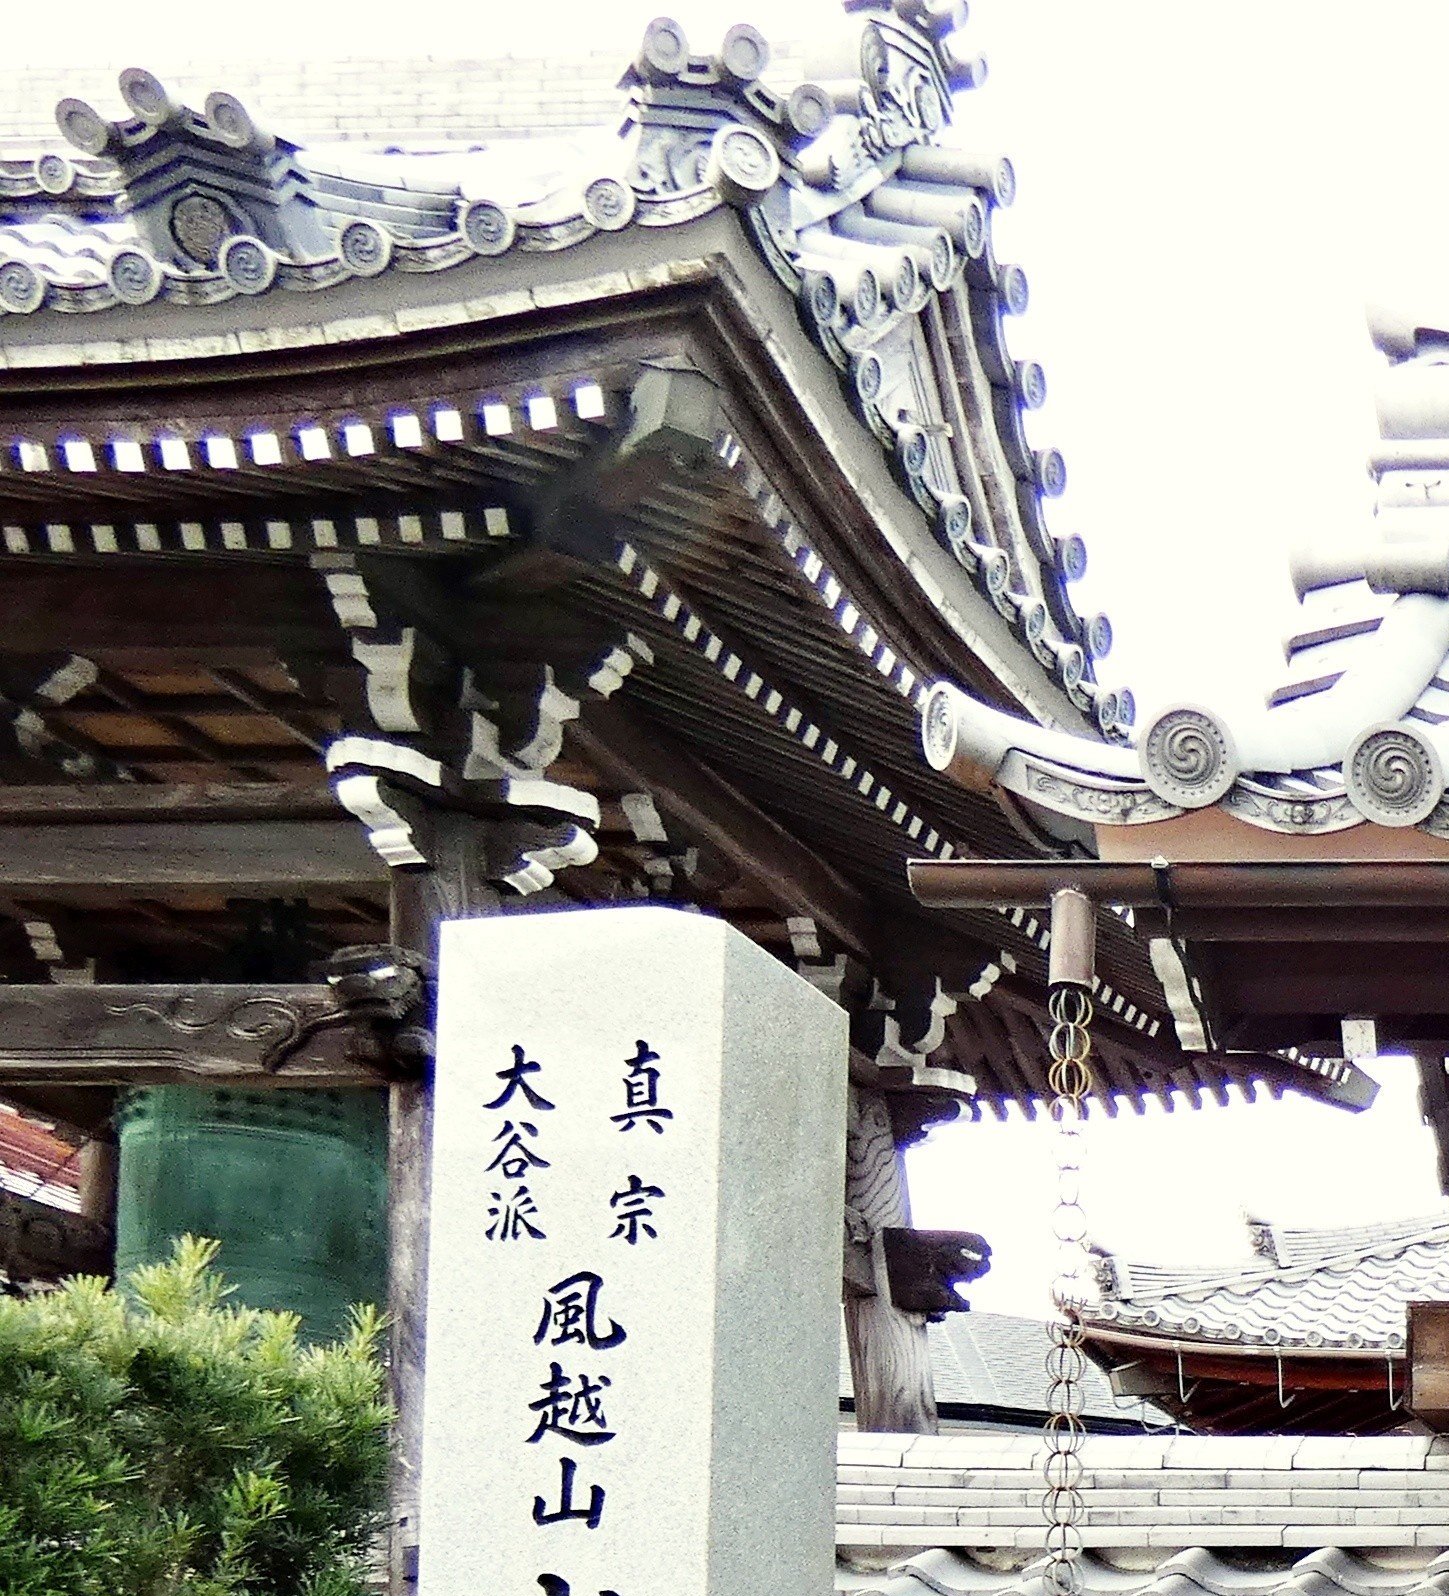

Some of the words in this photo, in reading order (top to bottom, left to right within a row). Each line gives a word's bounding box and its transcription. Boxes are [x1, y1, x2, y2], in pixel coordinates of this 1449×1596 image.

[482, 1044, 556, 1243] 大谷派
[609, 1039, 673, 1246] 真宗
